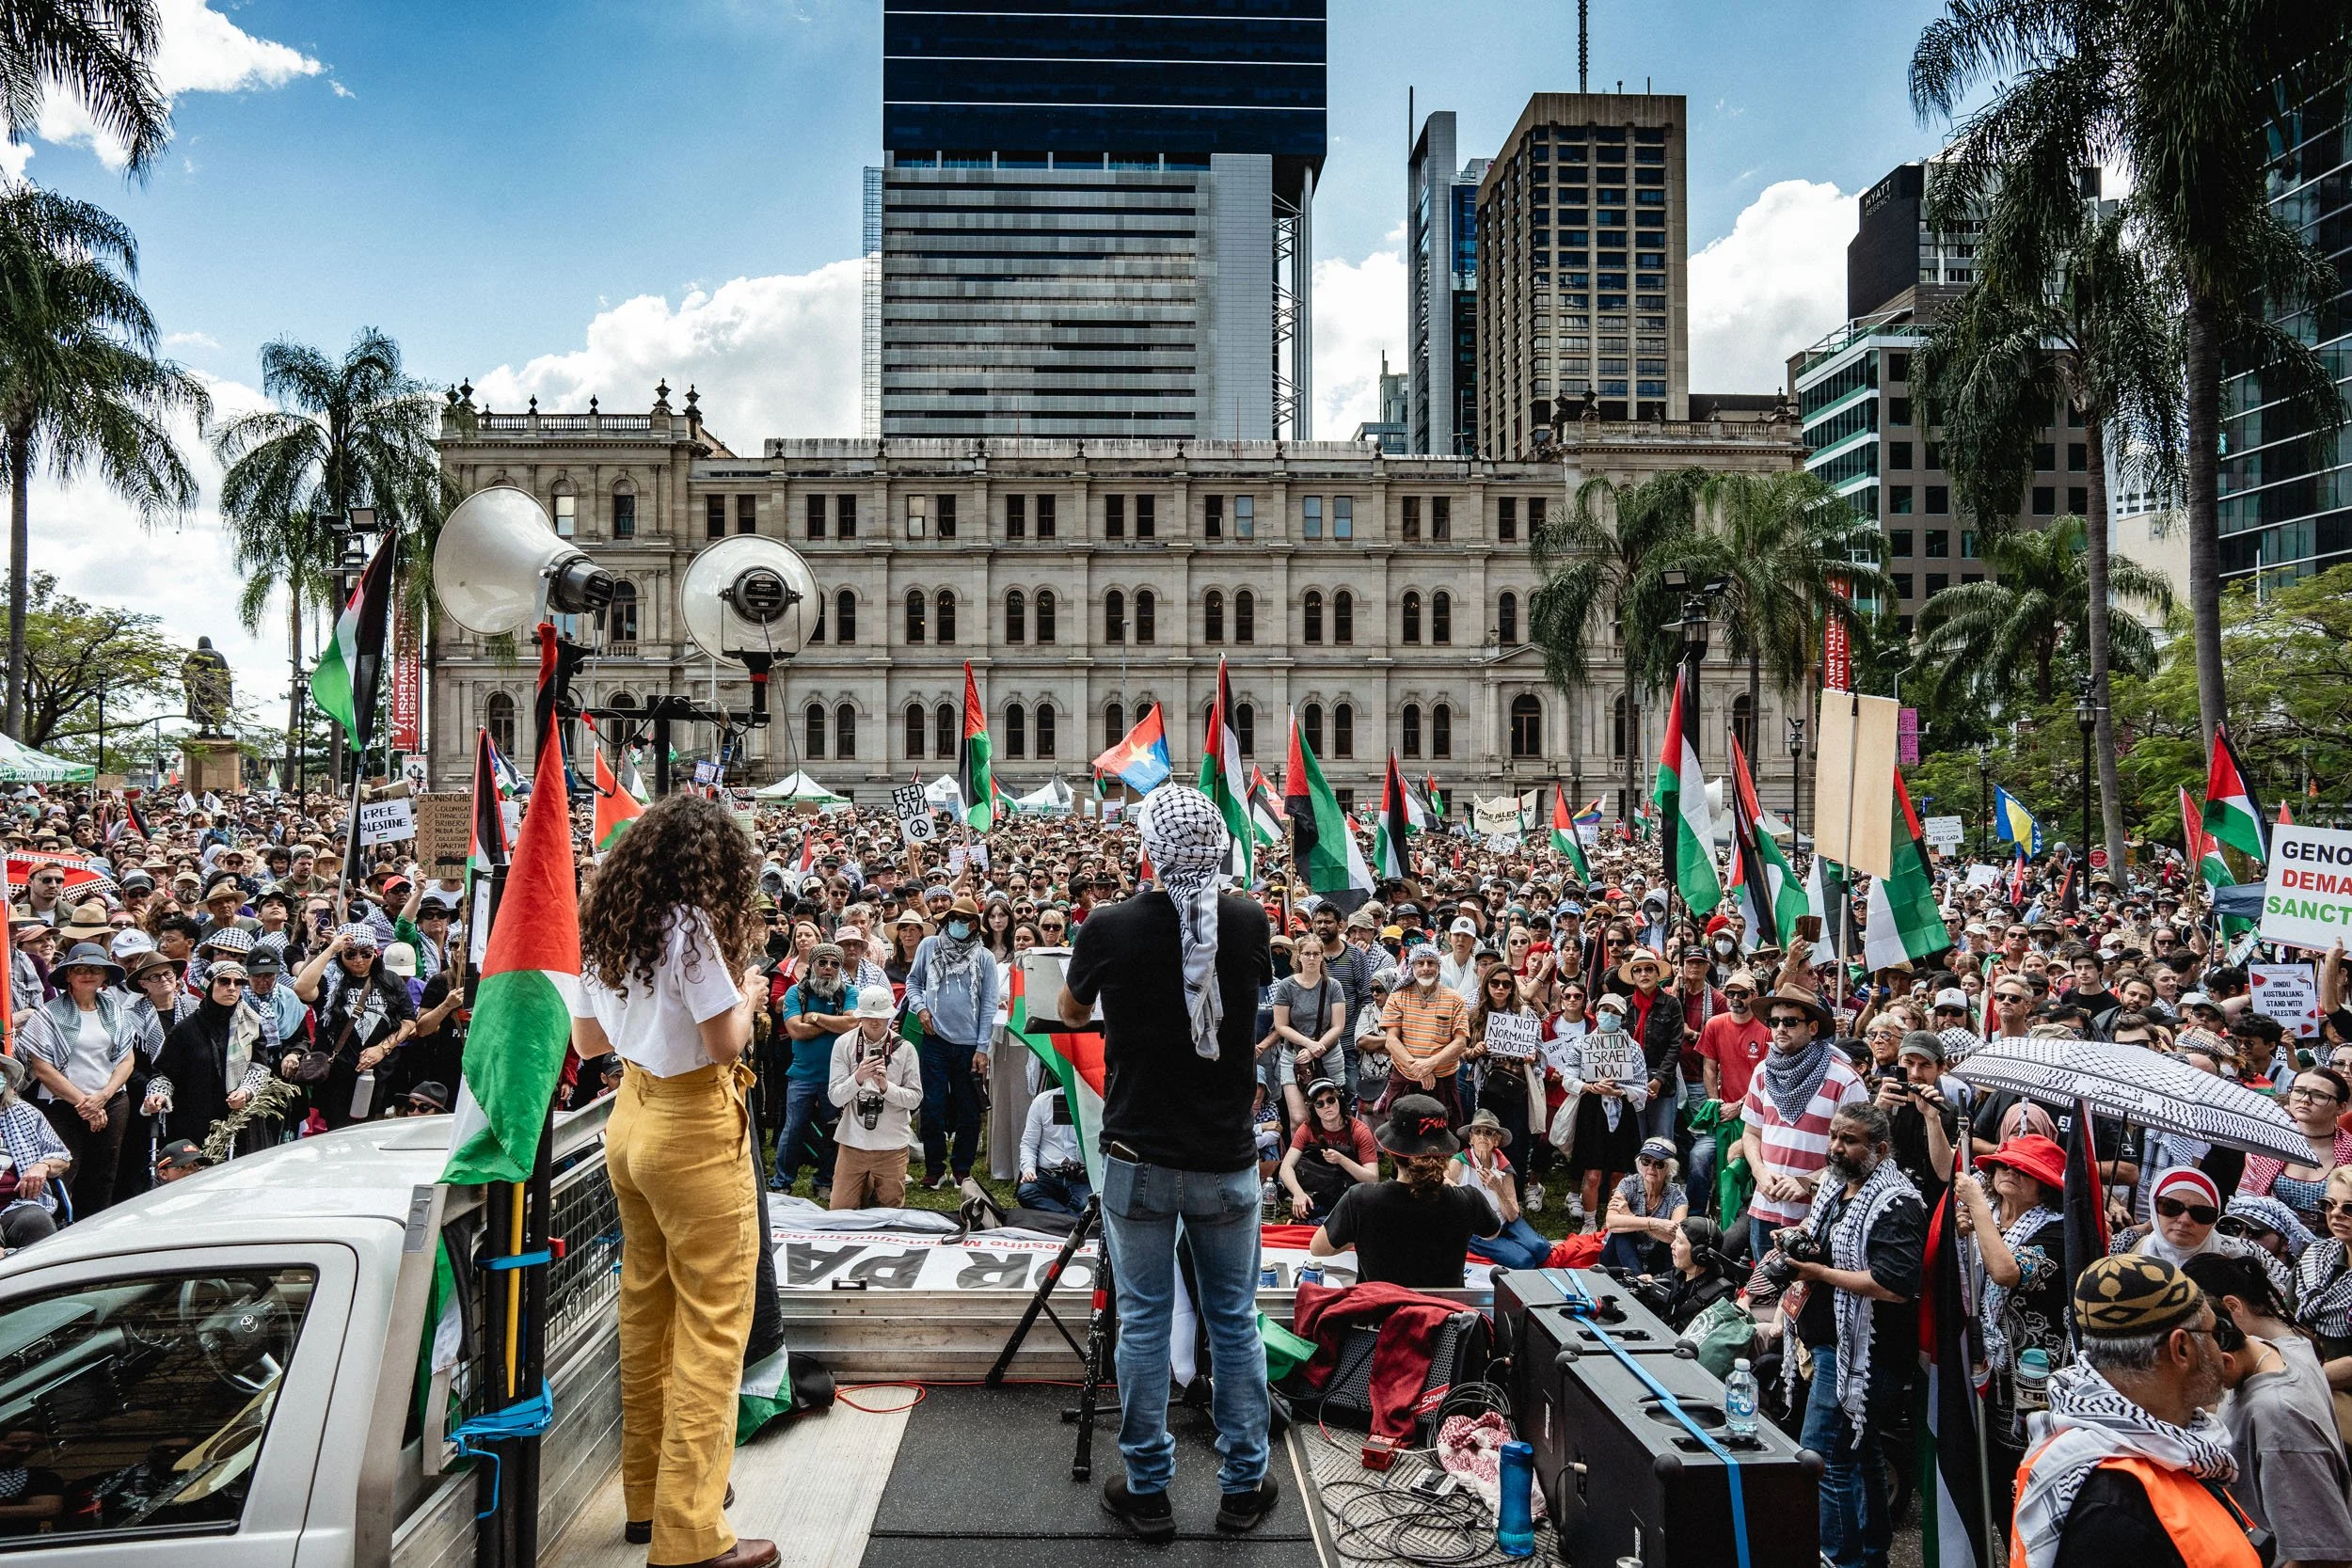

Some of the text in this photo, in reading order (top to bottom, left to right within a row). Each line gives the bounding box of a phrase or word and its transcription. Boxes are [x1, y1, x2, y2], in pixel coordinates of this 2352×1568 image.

[54, 768, 65, 781] MP
[419, 794, 452, 802] ZIONIST
[892, 784, 925, 804] FEED
[363, 805, 398, 820] FREE
[734, 802, 750, 811] NOW
[896, 798, 930, 821] GAZA
[2281, 841, 2352, 866] GENO
[428, 865, 464, 878] PALES
[2281, 868, 2352, 895] DEMA
[2265, 895, 2352, 926] SANCT
[1491, 1015, 1538, 1032] DO NOT
[1488, 1027, 1537, 1044] NORMALISE
[1583, 1035, 1629, 1051] SANCTION
[1486, 1038, 1534, 1055] GENOCIDE
[1585, 1051, 1631, 1064] ISRAEL
[1595, 1064, 1623, 1078] NOW
[2092, 1085, 2143, 1103] فلسطين
[990, 1241, 1092, 1253] Plestine
[1421, 1390, 1447, 1408] Street
